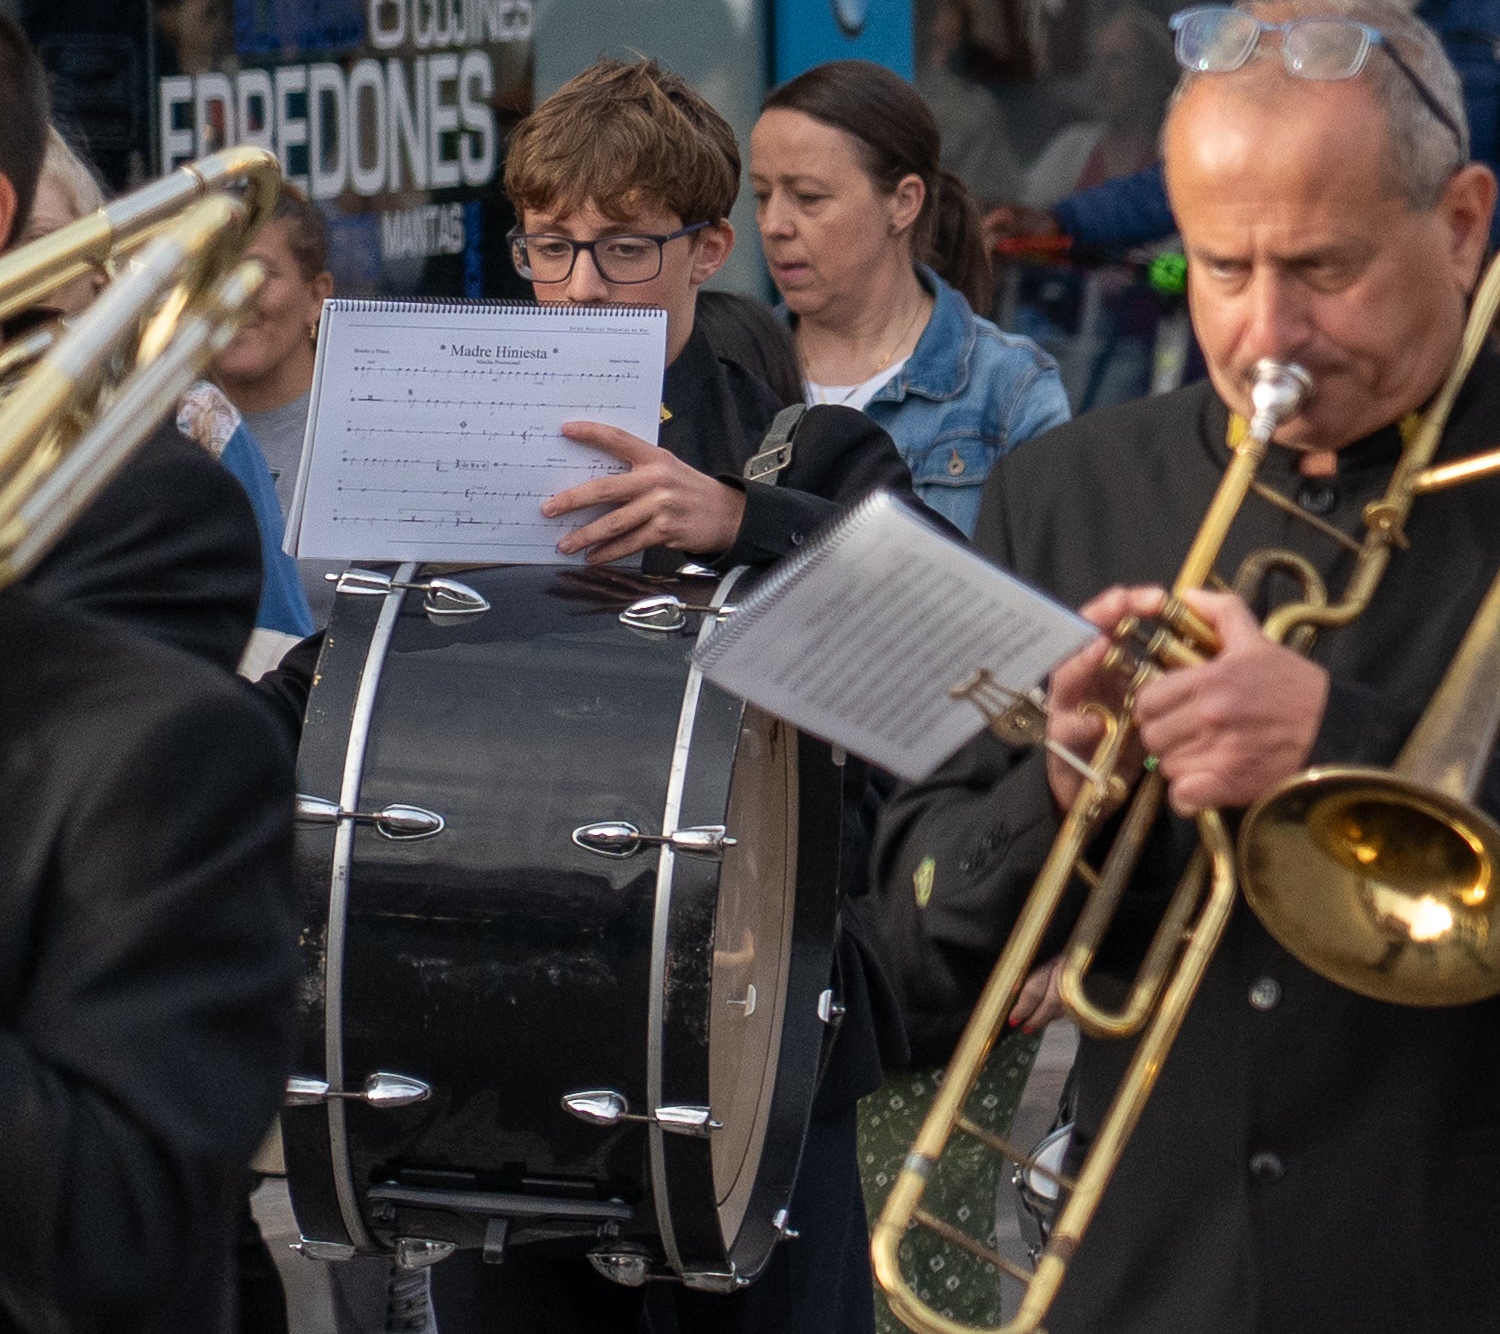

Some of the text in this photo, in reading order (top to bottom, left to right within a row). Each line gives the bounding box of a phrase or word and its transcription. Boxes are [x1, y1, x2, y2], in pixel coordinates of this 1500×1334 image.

[381, 202, 466, 260] MANTAS
[450, 343, 548, 360] Madre Hiniesta
